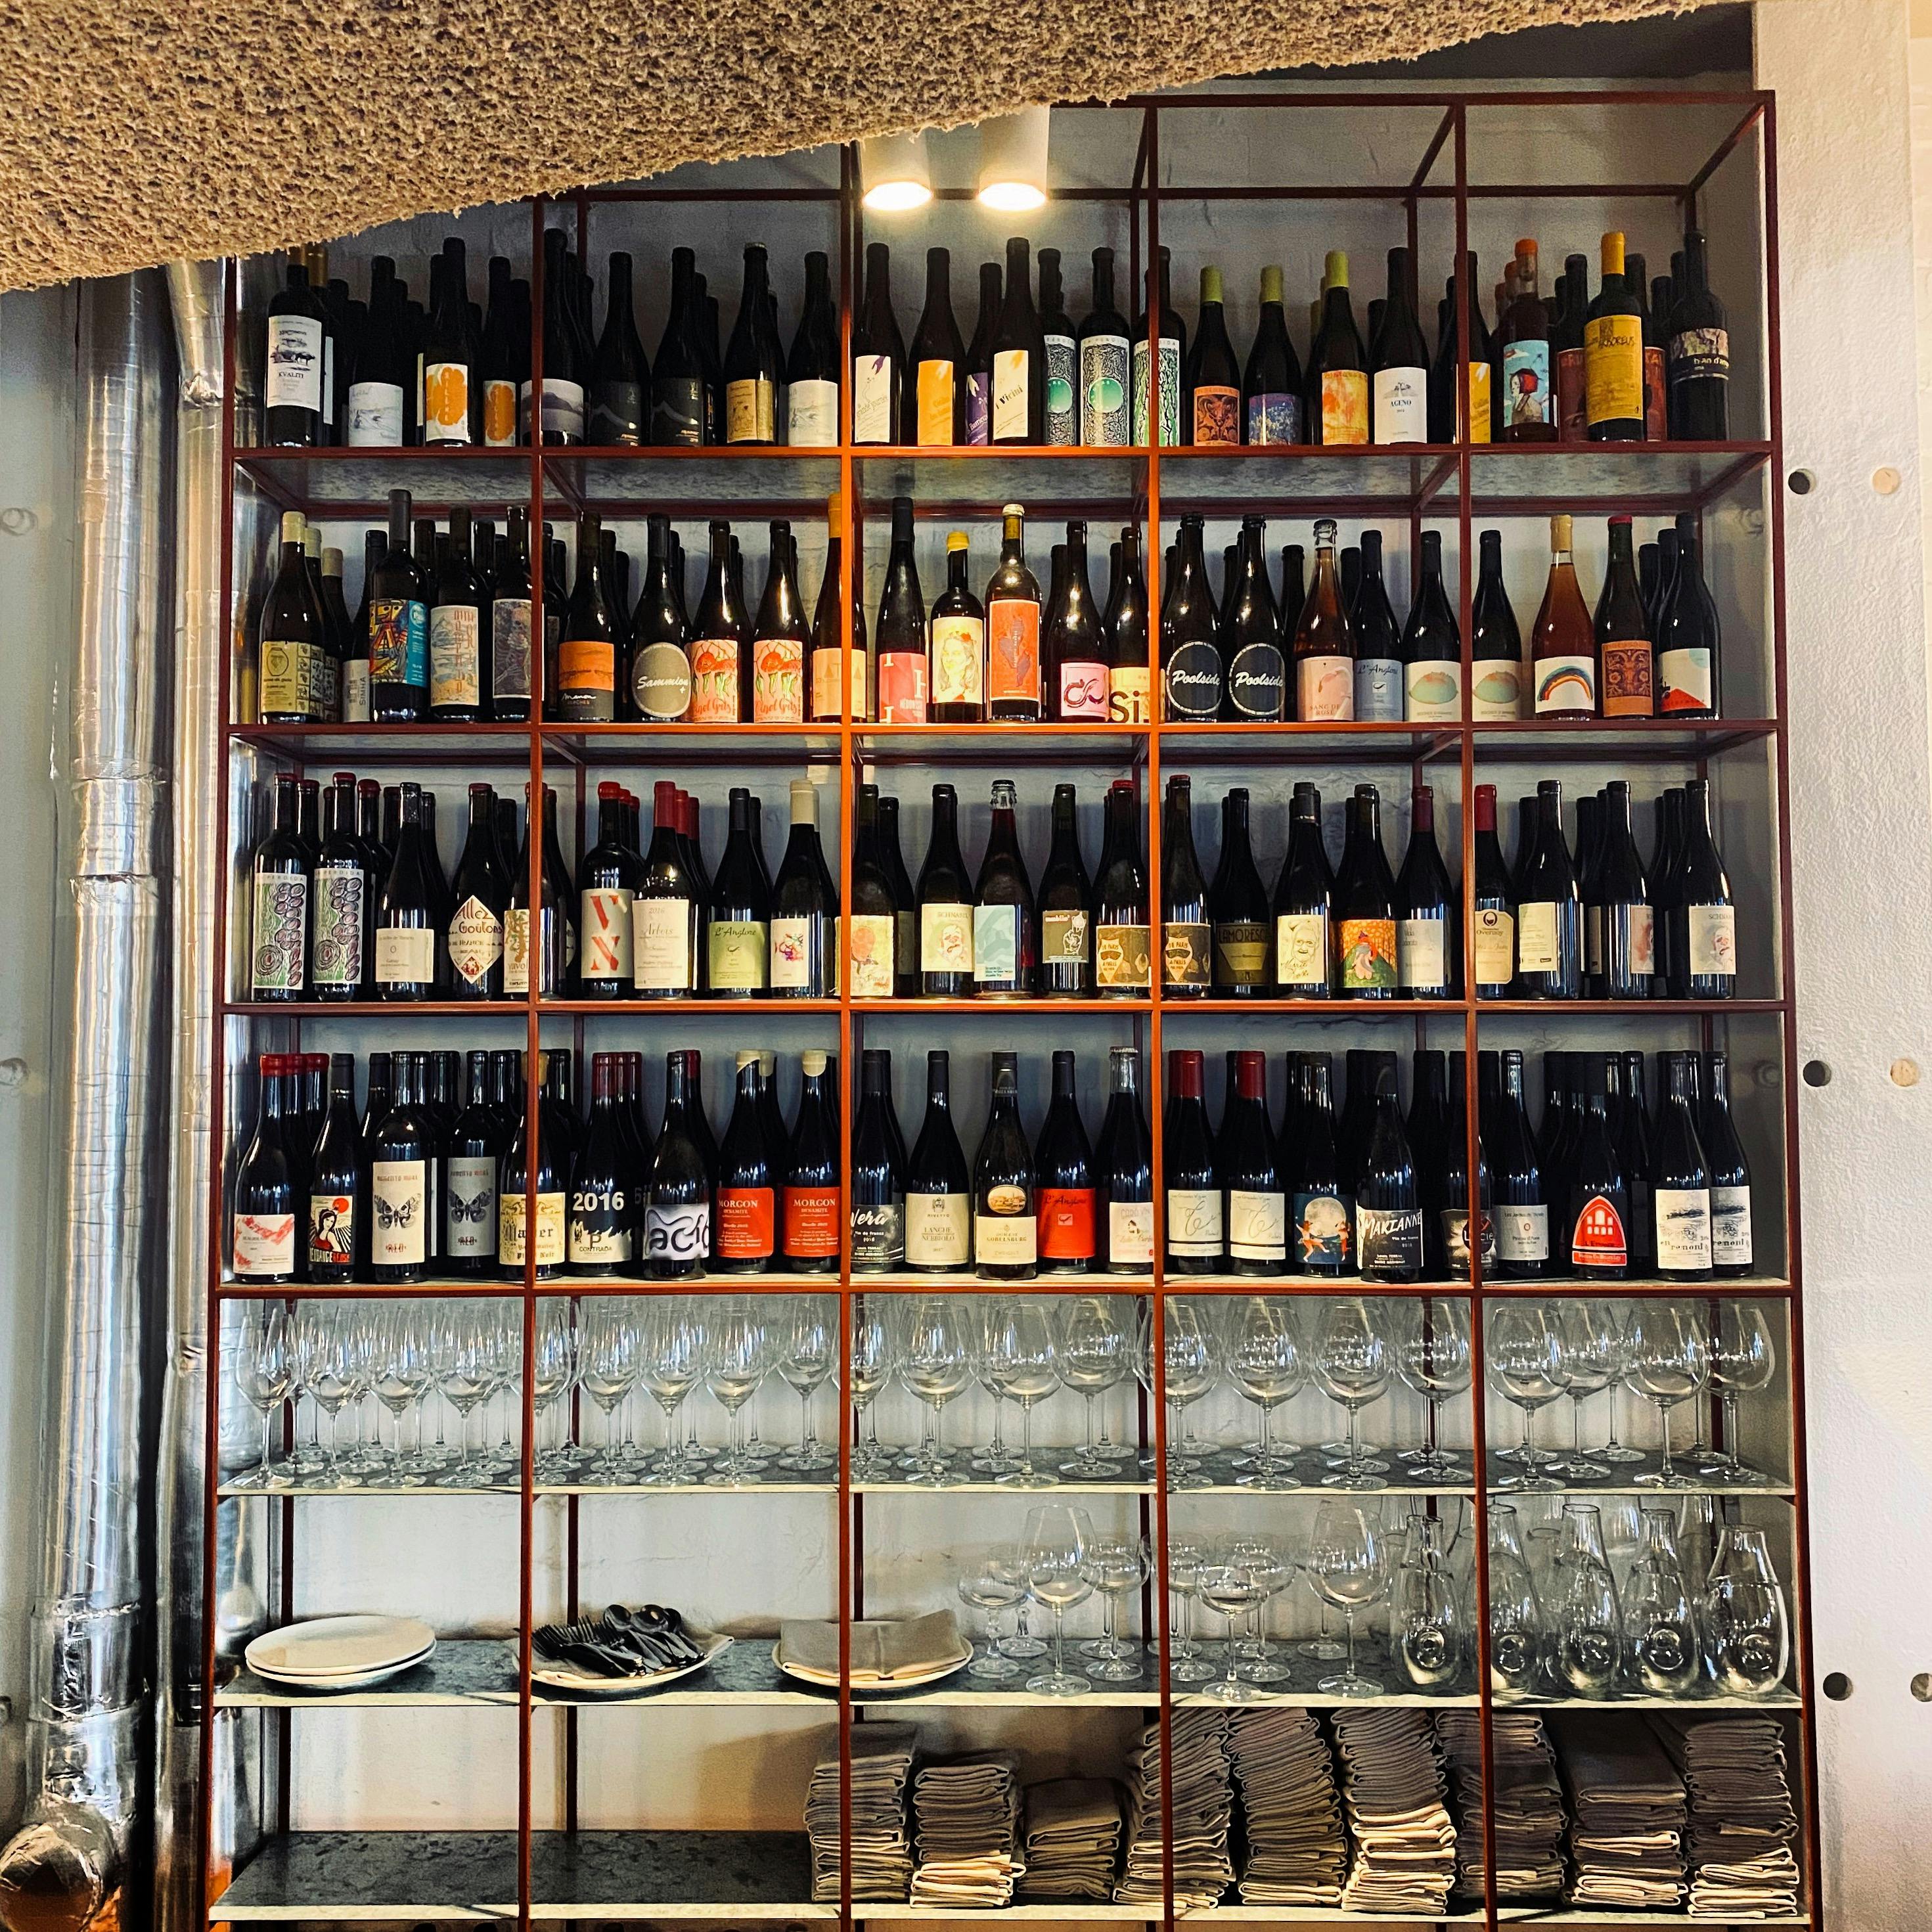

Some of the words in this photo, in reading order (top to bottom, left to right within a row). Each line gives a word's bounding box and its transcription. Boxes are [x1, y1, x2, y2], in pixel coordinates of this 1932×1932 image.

[1598, 336, 1634, 349] ARBOREUS
[999, 385, 1023, 404] Vicini
[1172, 669, 1220, 686] Poolside
[1235, 671, 1284, 688] Poolside
[454, 898, 493, 920] Allez
[459, 921, 503, 934] Goûtons
[715, 926, 757, 938] L'Anglore
[573, 1192, 624, 1212] 2016
[719, 1200, 758, 1208] MORGON
[793, 1198, 836, 1207] MORGON
[850, 1208, 889, 1227] Vera
[1366, 1212, 1422, 1240] MARIANNE
[504, 1222, 553, 1242] Maer
[1464, 1230, 1493, 1242] Lcie
